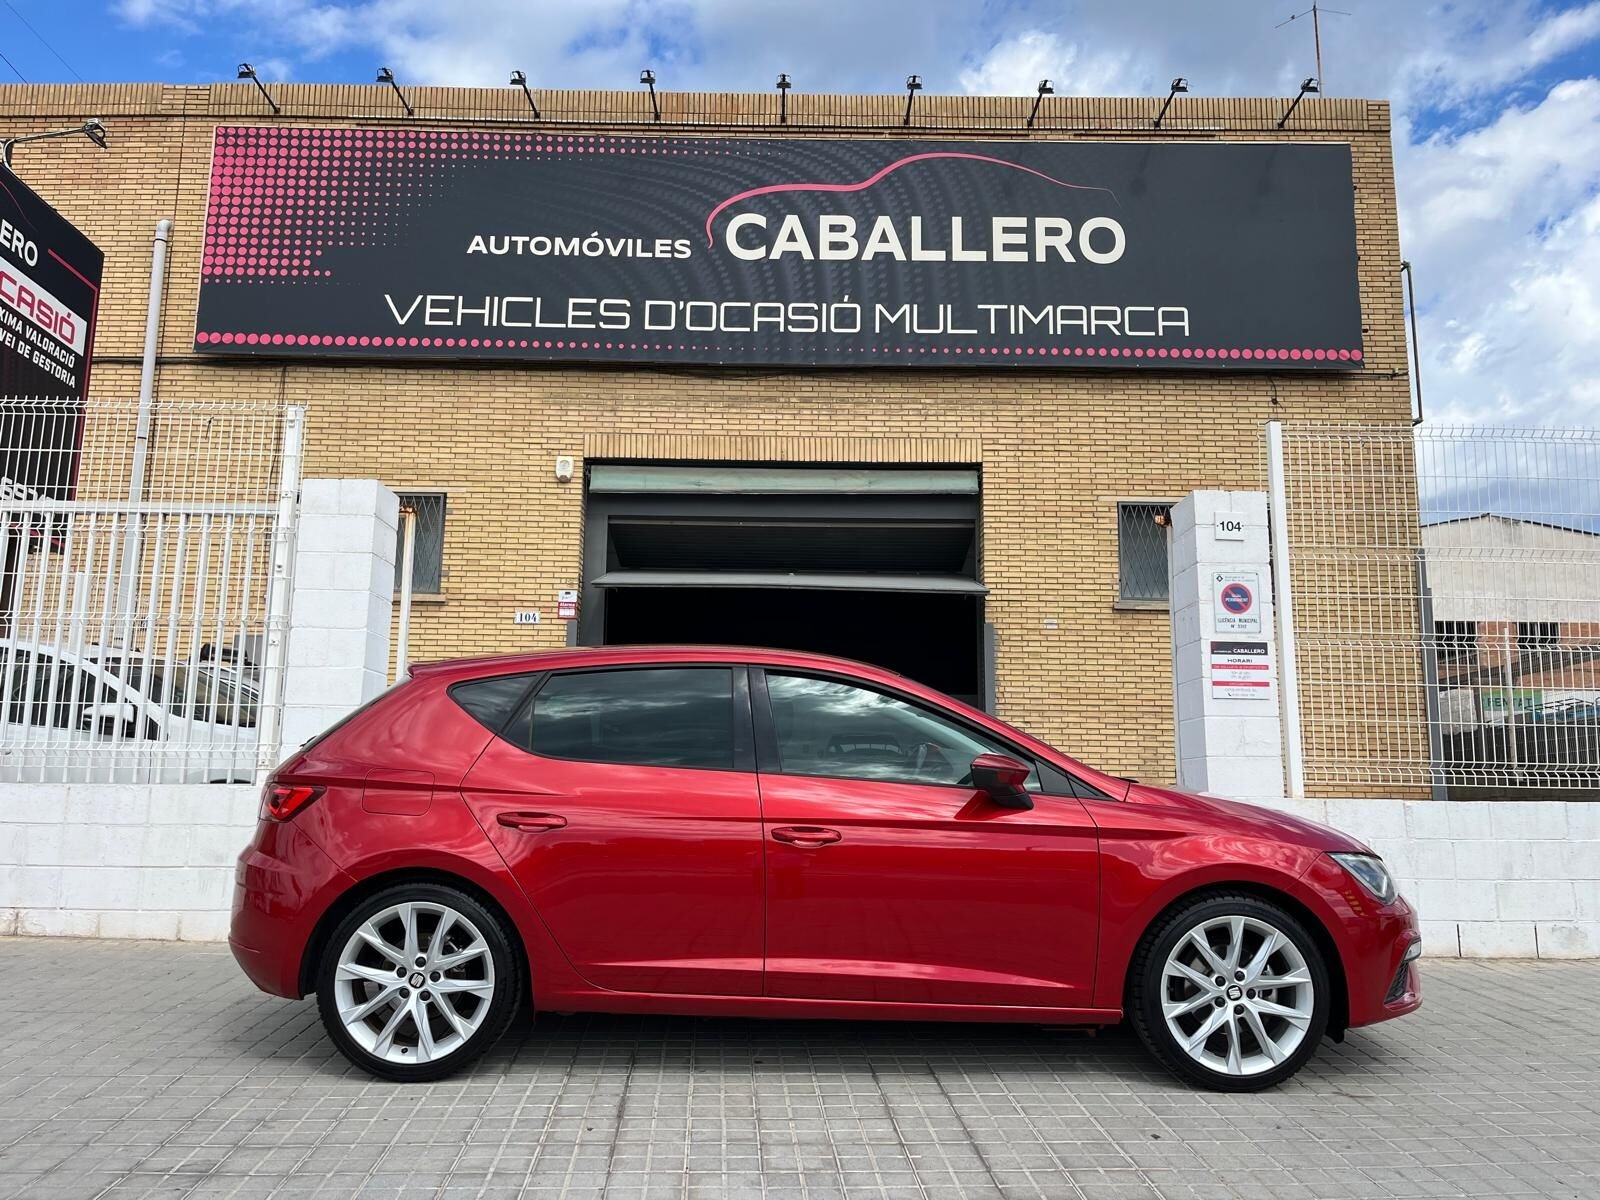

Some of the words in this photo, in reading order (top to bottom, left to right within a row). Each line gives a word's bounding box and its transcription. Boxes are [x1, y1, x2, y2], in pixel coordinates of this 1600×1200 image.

[466, 231, 692, 259] AUTOMÓVILES
[725, 213, 1126, 264] CABALLERO
[384, 294, 631, 331] VEHICLES
[644, 295, 861, 334] D'OCASIÓ
[875, 303, 1190, 337] MULTIMARCA
[17, 340, 32, 359] DE
[32, 350, 76, 389] GESTORIA
[25, 325, 75, 369] VALORACIÓ
[1219, 520, 1242, 532] 104
[519, 612, 537, 623] 104
